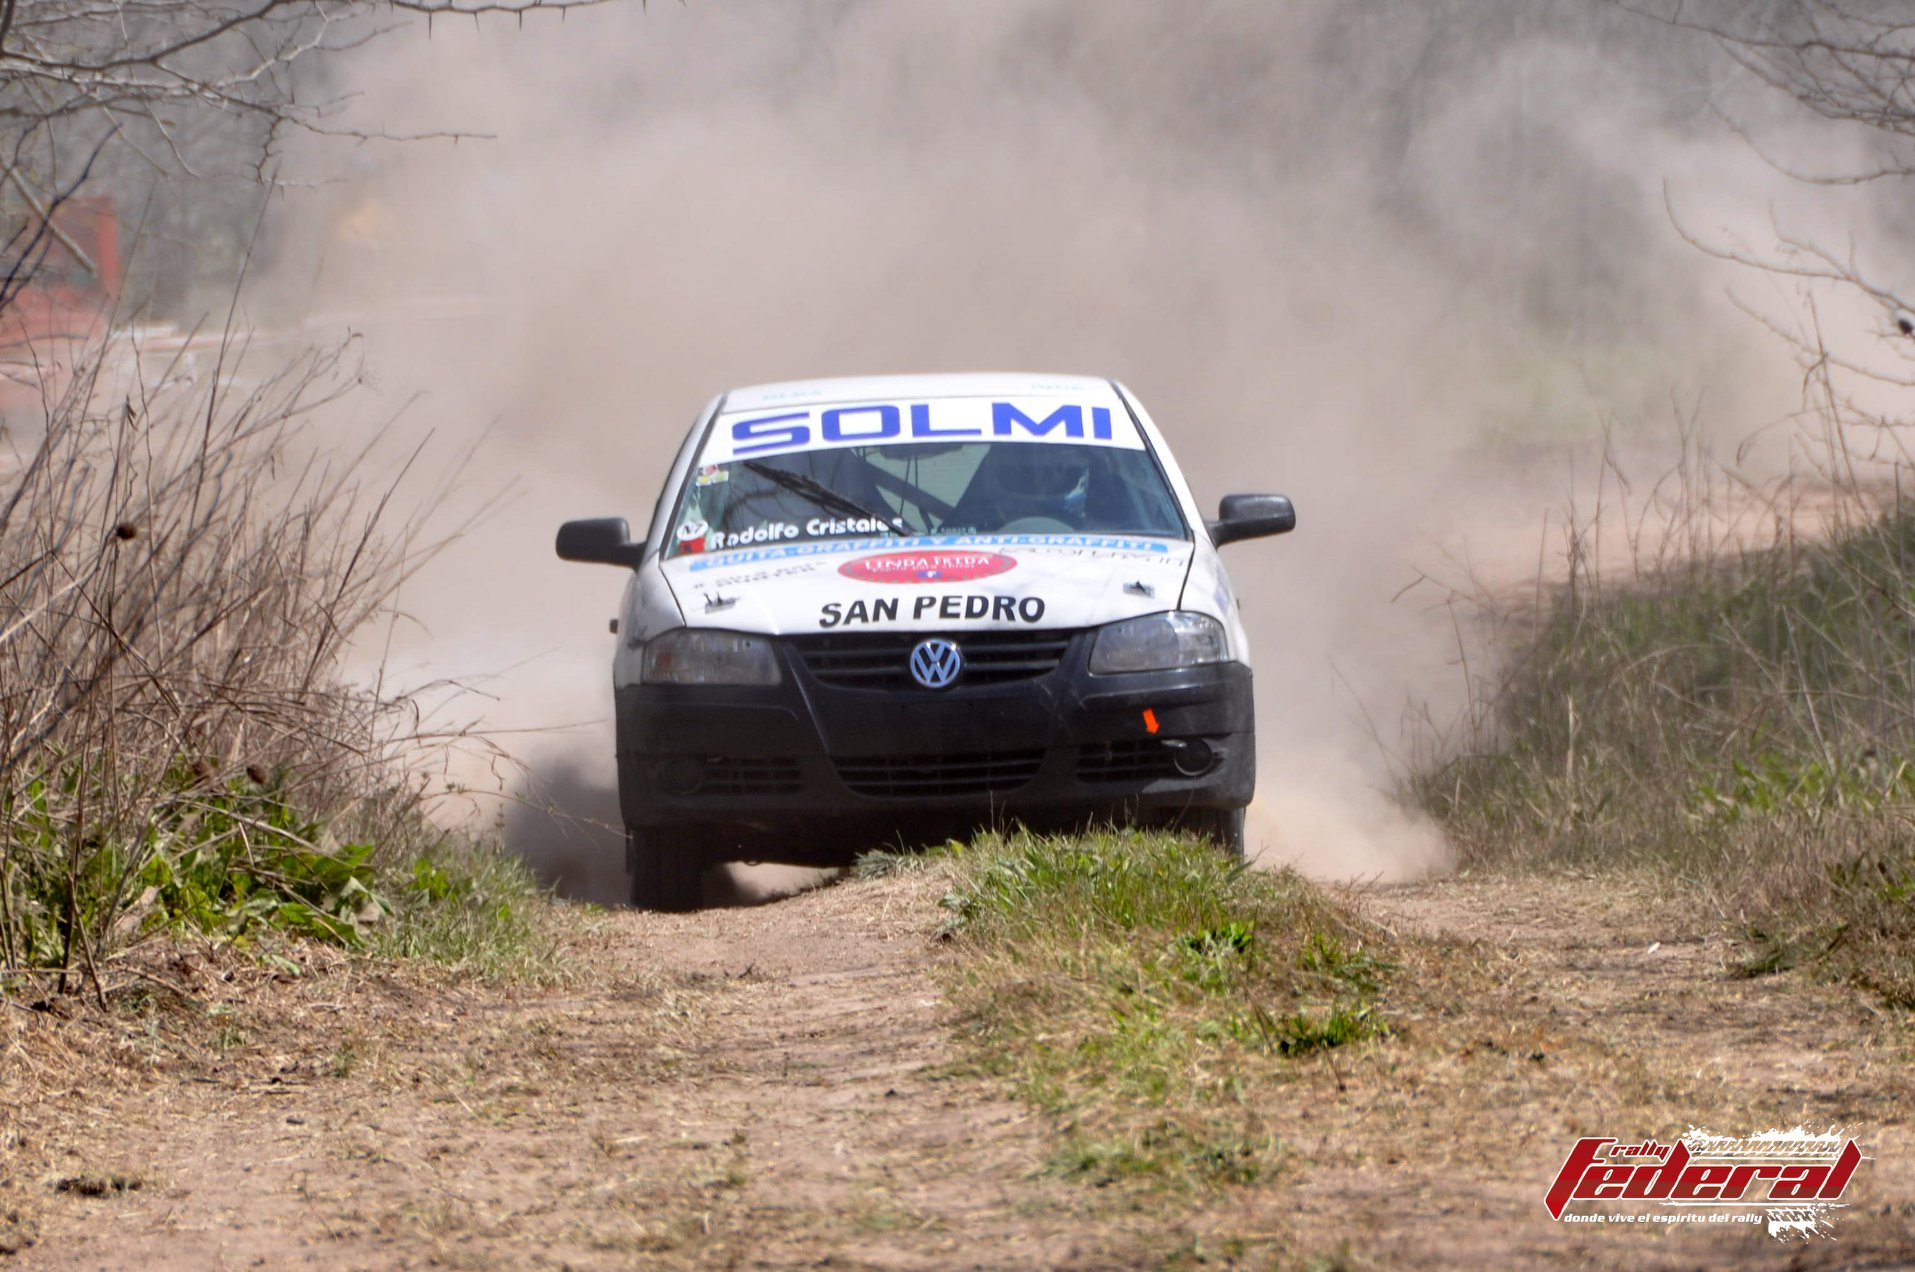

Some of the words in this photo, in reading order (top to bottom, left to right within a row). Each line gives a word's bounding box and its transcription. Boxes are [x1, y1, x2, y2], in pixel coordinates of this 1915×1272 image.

[732, 402, 1113, 455] SOLMI
[711, 523, 799, 549] Rodolfo
[819, 597, 899, 628] SAN
[912, 595, 1046, 623] PEDRO
